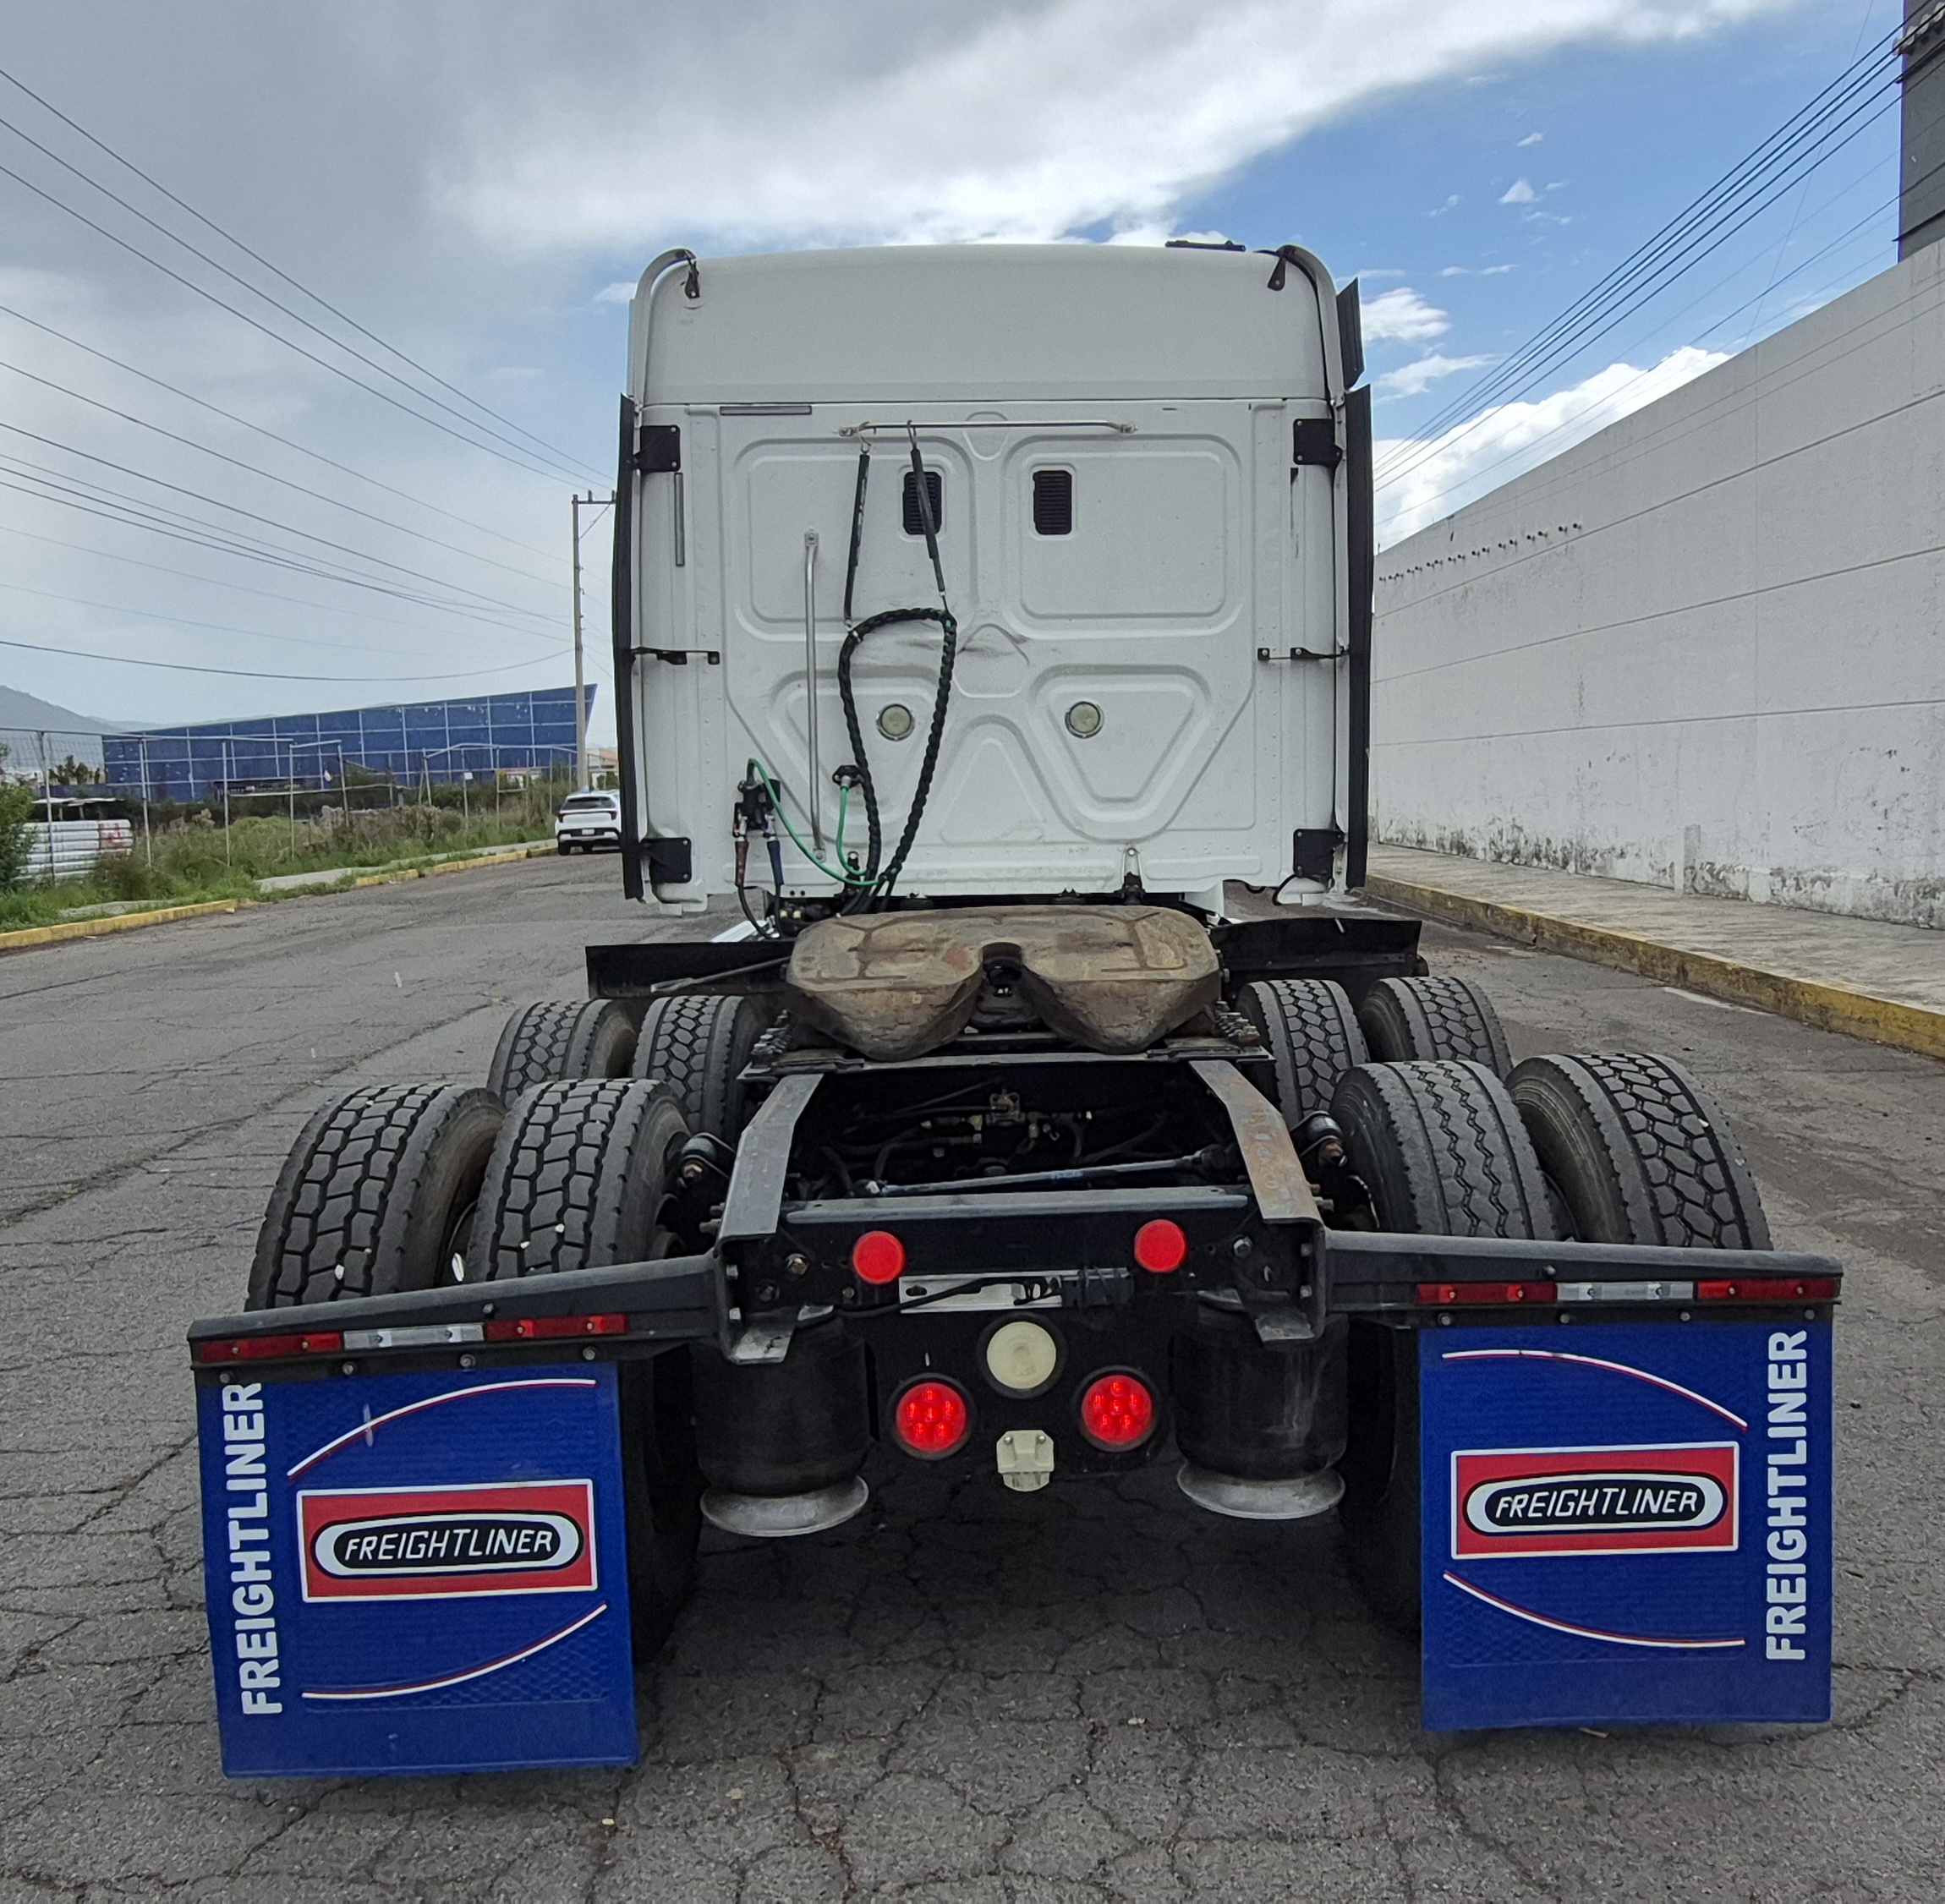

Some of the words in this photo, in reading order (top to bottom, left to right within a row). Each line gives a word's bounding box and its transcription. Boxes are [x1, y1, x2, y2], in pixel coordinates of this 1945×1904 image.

[222, 1382, 282, 1715] FREIGHTLINER
[345, 1529, 553, 1561] FREIGHTLINER
[1496, 1488, 1697, 1518] FREIGHTLINER
[1766, 1331, 1807, 1661] FREIGHTLINER
